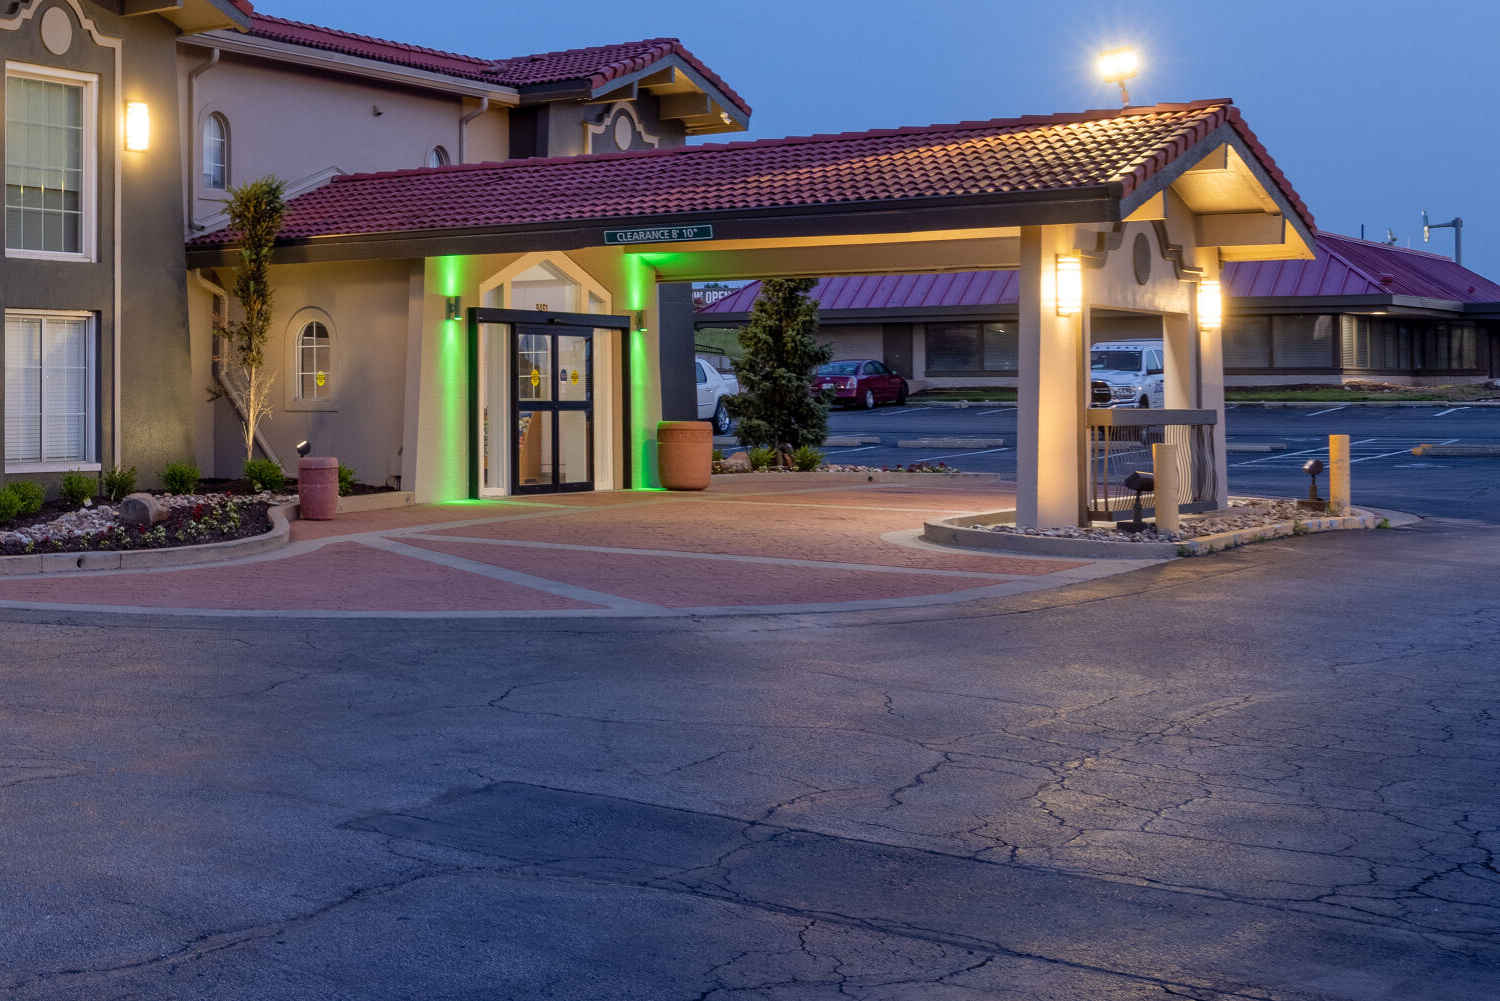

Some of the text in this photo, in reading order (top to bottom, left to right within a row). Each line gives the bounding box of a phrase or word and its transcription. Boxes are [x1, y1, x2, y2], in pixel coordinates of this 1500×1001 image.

[616, 228, 698, 242] CLEARANCE 8' 10"
